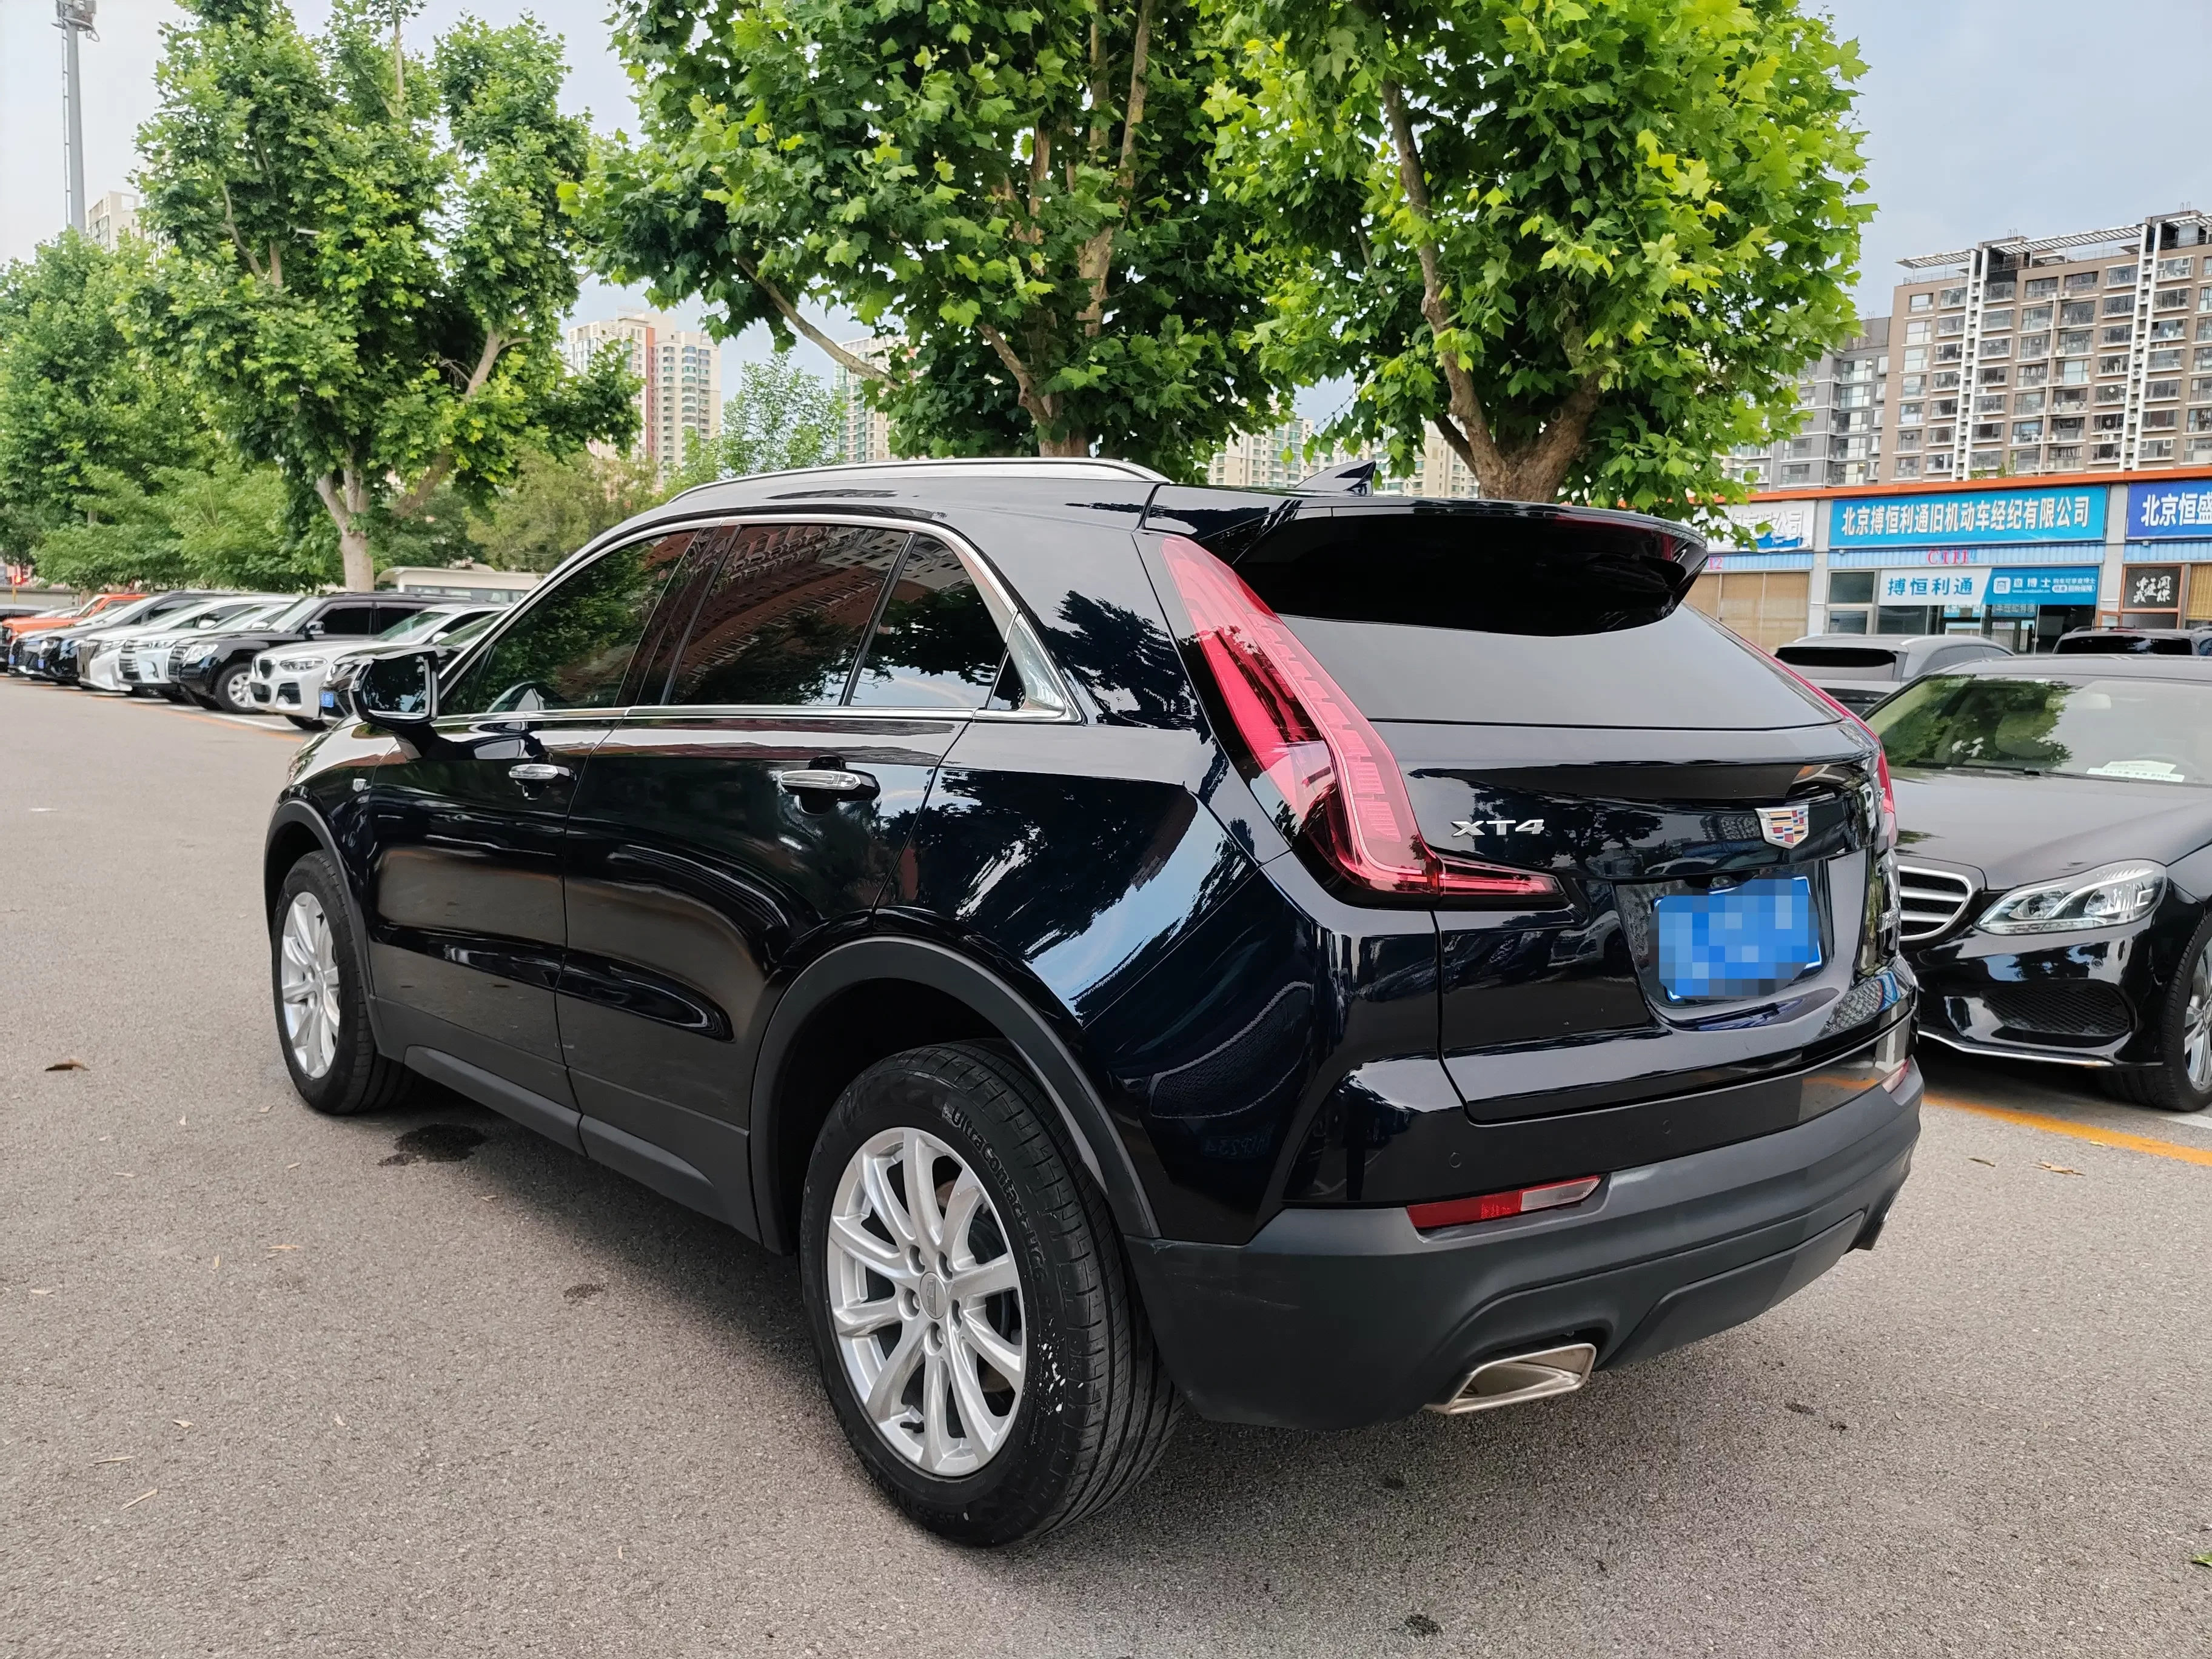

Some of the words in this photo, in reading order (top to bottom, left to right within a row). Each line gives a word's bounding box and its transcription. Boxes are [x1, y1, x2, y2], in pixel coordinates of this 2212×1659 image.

[2140, 491, 2212, 526] 北京恒盛
[1450, 819, 1544, 836] XT4
